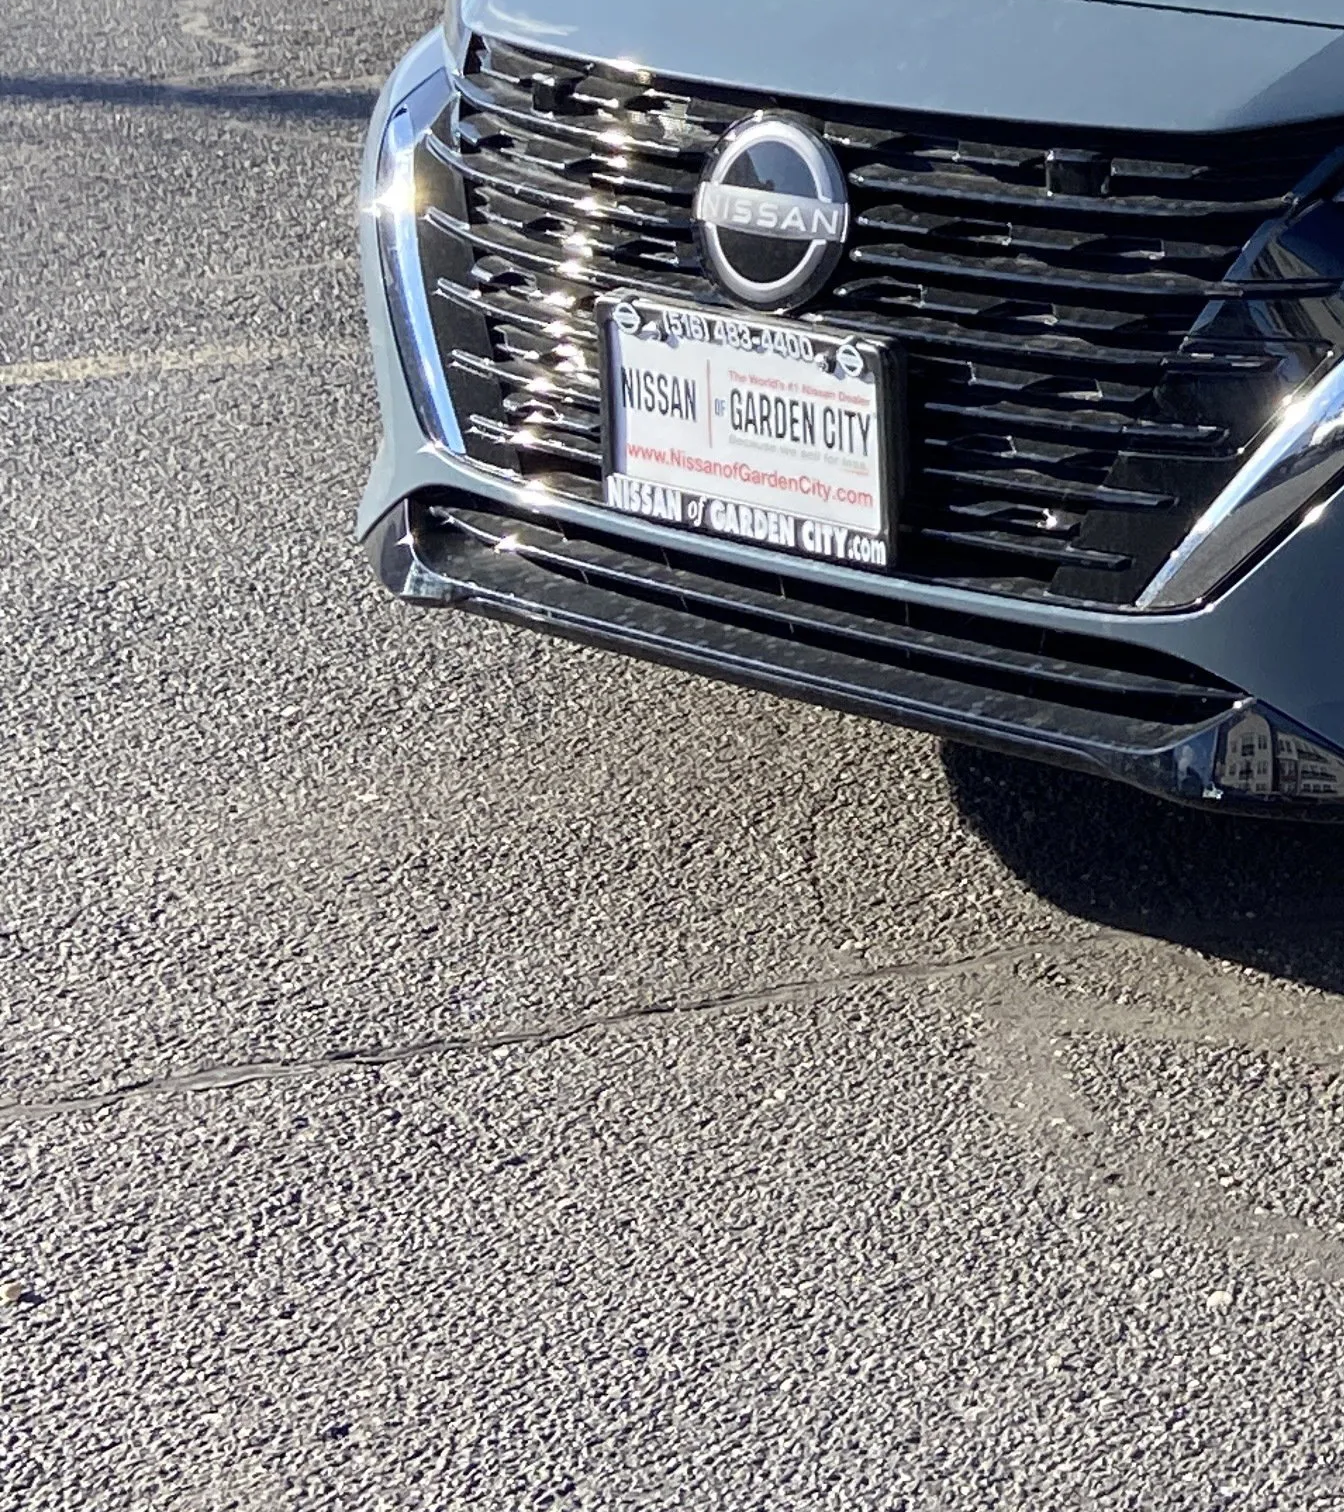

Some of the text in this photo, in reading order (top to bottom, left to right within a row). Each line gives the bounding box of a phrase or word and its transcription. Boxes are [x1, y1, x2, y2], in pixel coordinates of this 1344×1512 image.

[702, 192, 839, 235] NISSAN
[663, 311, 709, 343] (516)
[714, 319, 815, 363] 483-4400
[621, 366, 697, 422] NISSAN
[714, 387, 872, 457] OF GARDEN CITY
[626, 443, 873, 508] www.NissanofGardenCity.com
[607, 475, 886, 566] NISSAN of GARDEN CITY.com
